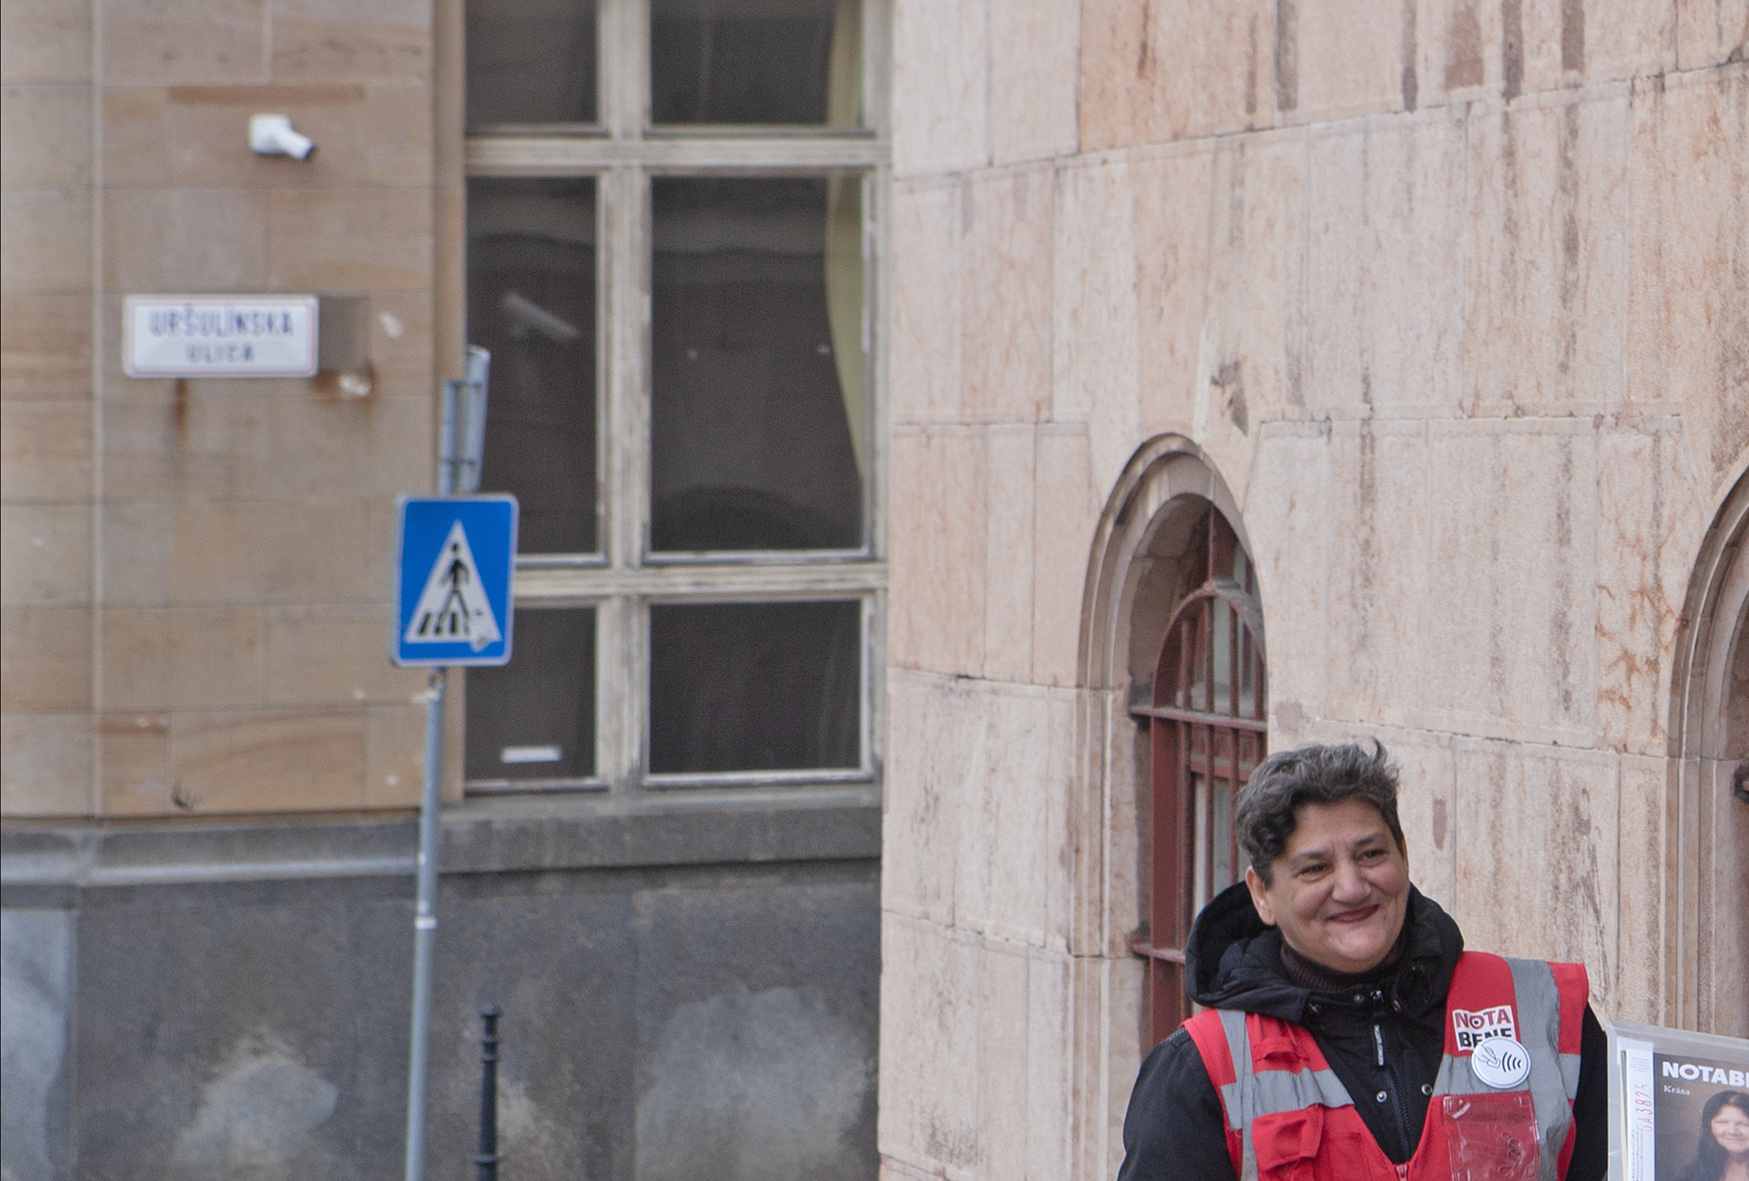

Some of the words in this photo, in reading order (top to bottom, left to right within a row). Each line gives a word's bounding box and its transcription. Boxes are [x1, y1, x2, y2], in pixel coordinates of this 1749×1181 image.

[186, 341, 255, 363] ULICA
[1455, 1009, 1512, 1029] NOTA
[1663, 1085, 1690, 1096] Krása
